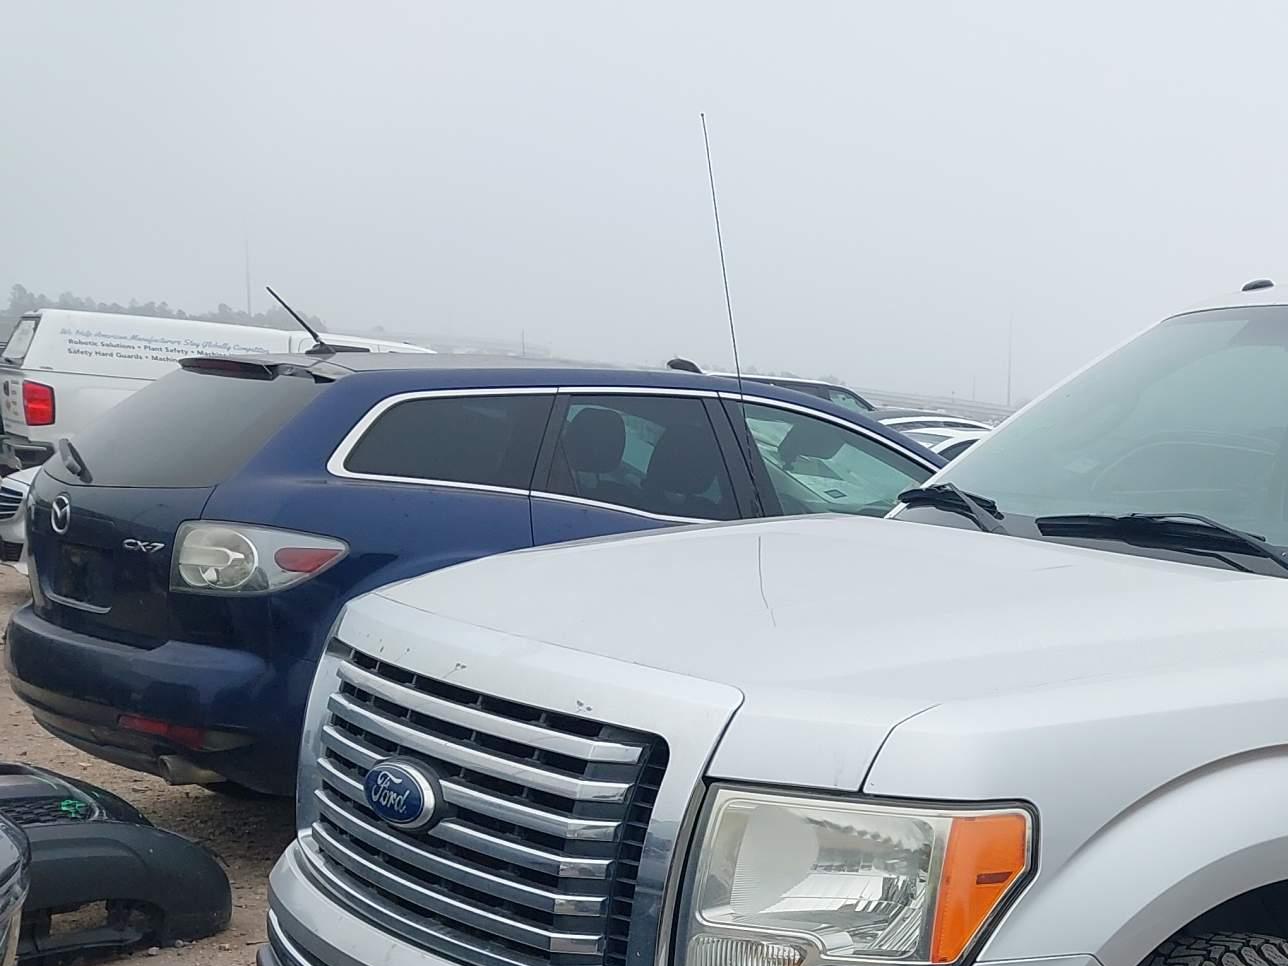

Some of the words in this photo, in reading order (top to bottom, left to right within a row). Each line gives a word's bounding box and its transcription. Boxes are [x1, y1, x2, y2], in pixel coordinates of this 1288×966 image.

[67, 348, 92, 357] Safety
[116, 352, 143, 360] Guards
[68, 339, 98, 347] Robotic
[100, 341, 135, 350] Solutions
[165, 346, 188, 355] Safety
[123, 539, 165, 552] CX-7
[371, 770, 411, 814] Ford
